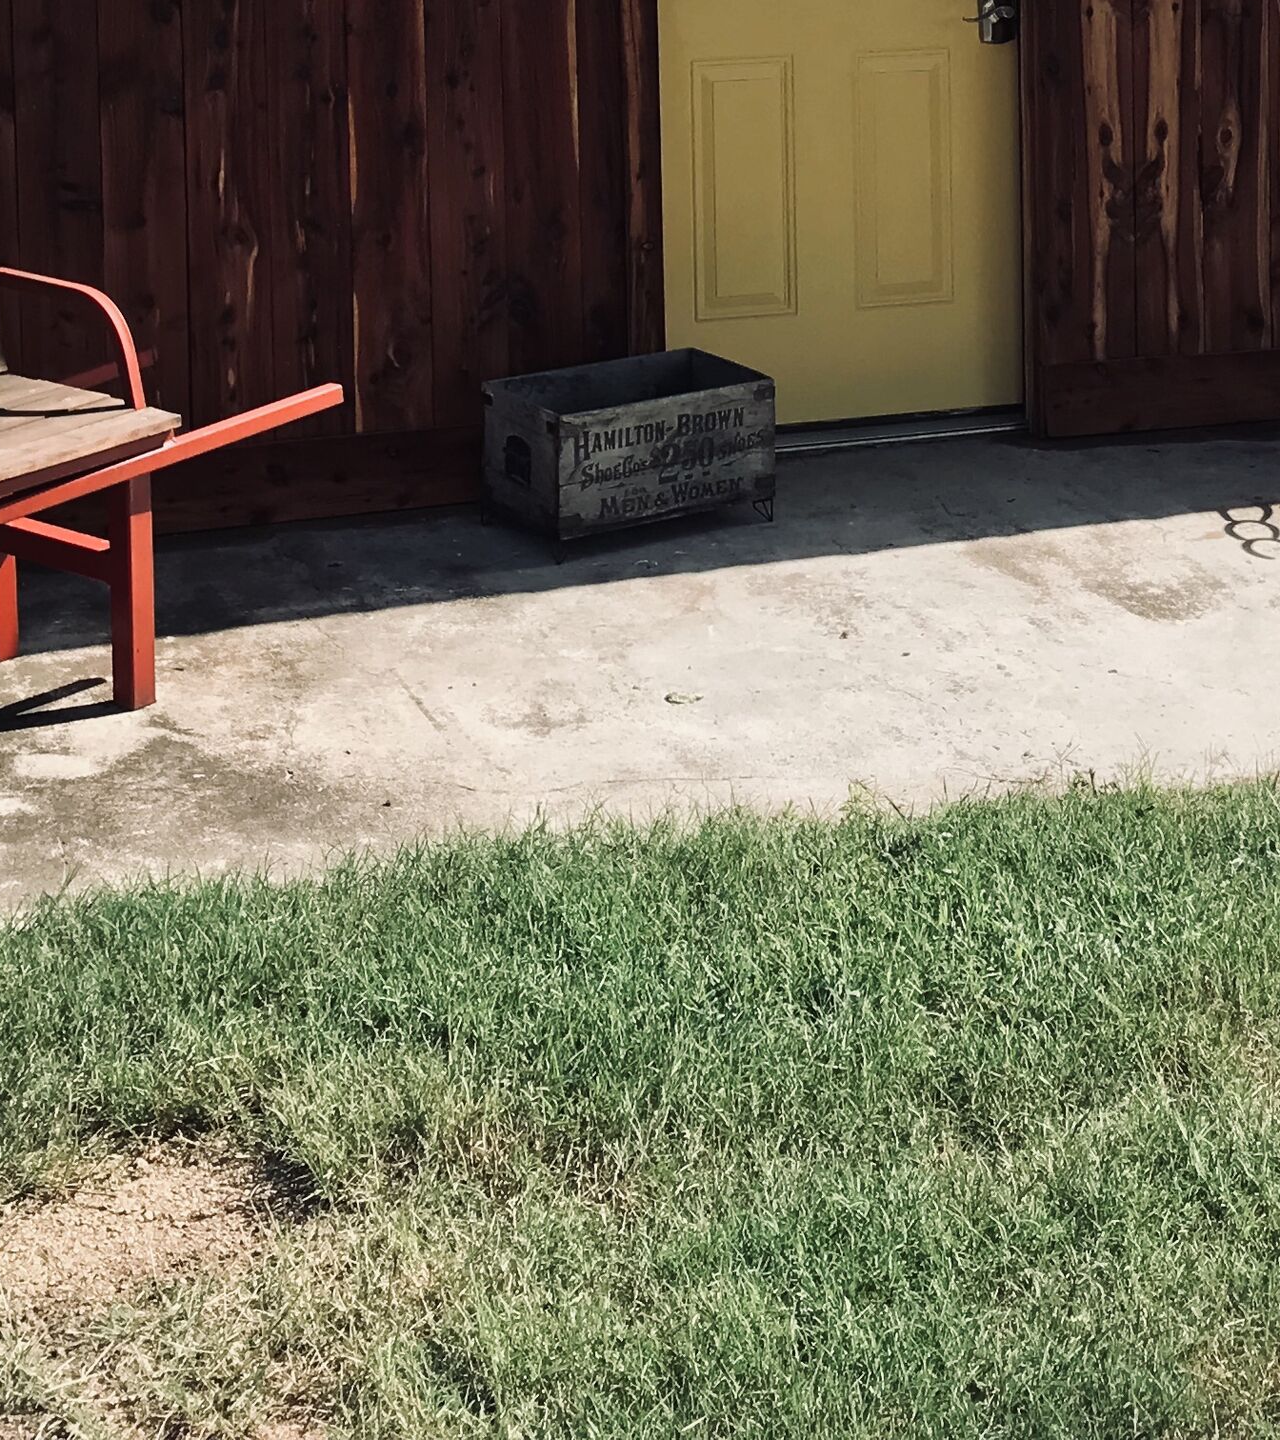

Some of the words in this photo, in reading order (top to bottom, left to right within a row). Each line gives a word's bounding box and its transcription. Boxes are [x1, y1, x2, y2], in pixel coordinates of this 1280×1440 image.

[574, 407, 744, 467] HAMILTON-BROWN
[599, 494, 650, 519] MEN
[654, 492, 669, 507] &
[671, 476, 744, 504] WOMEN
